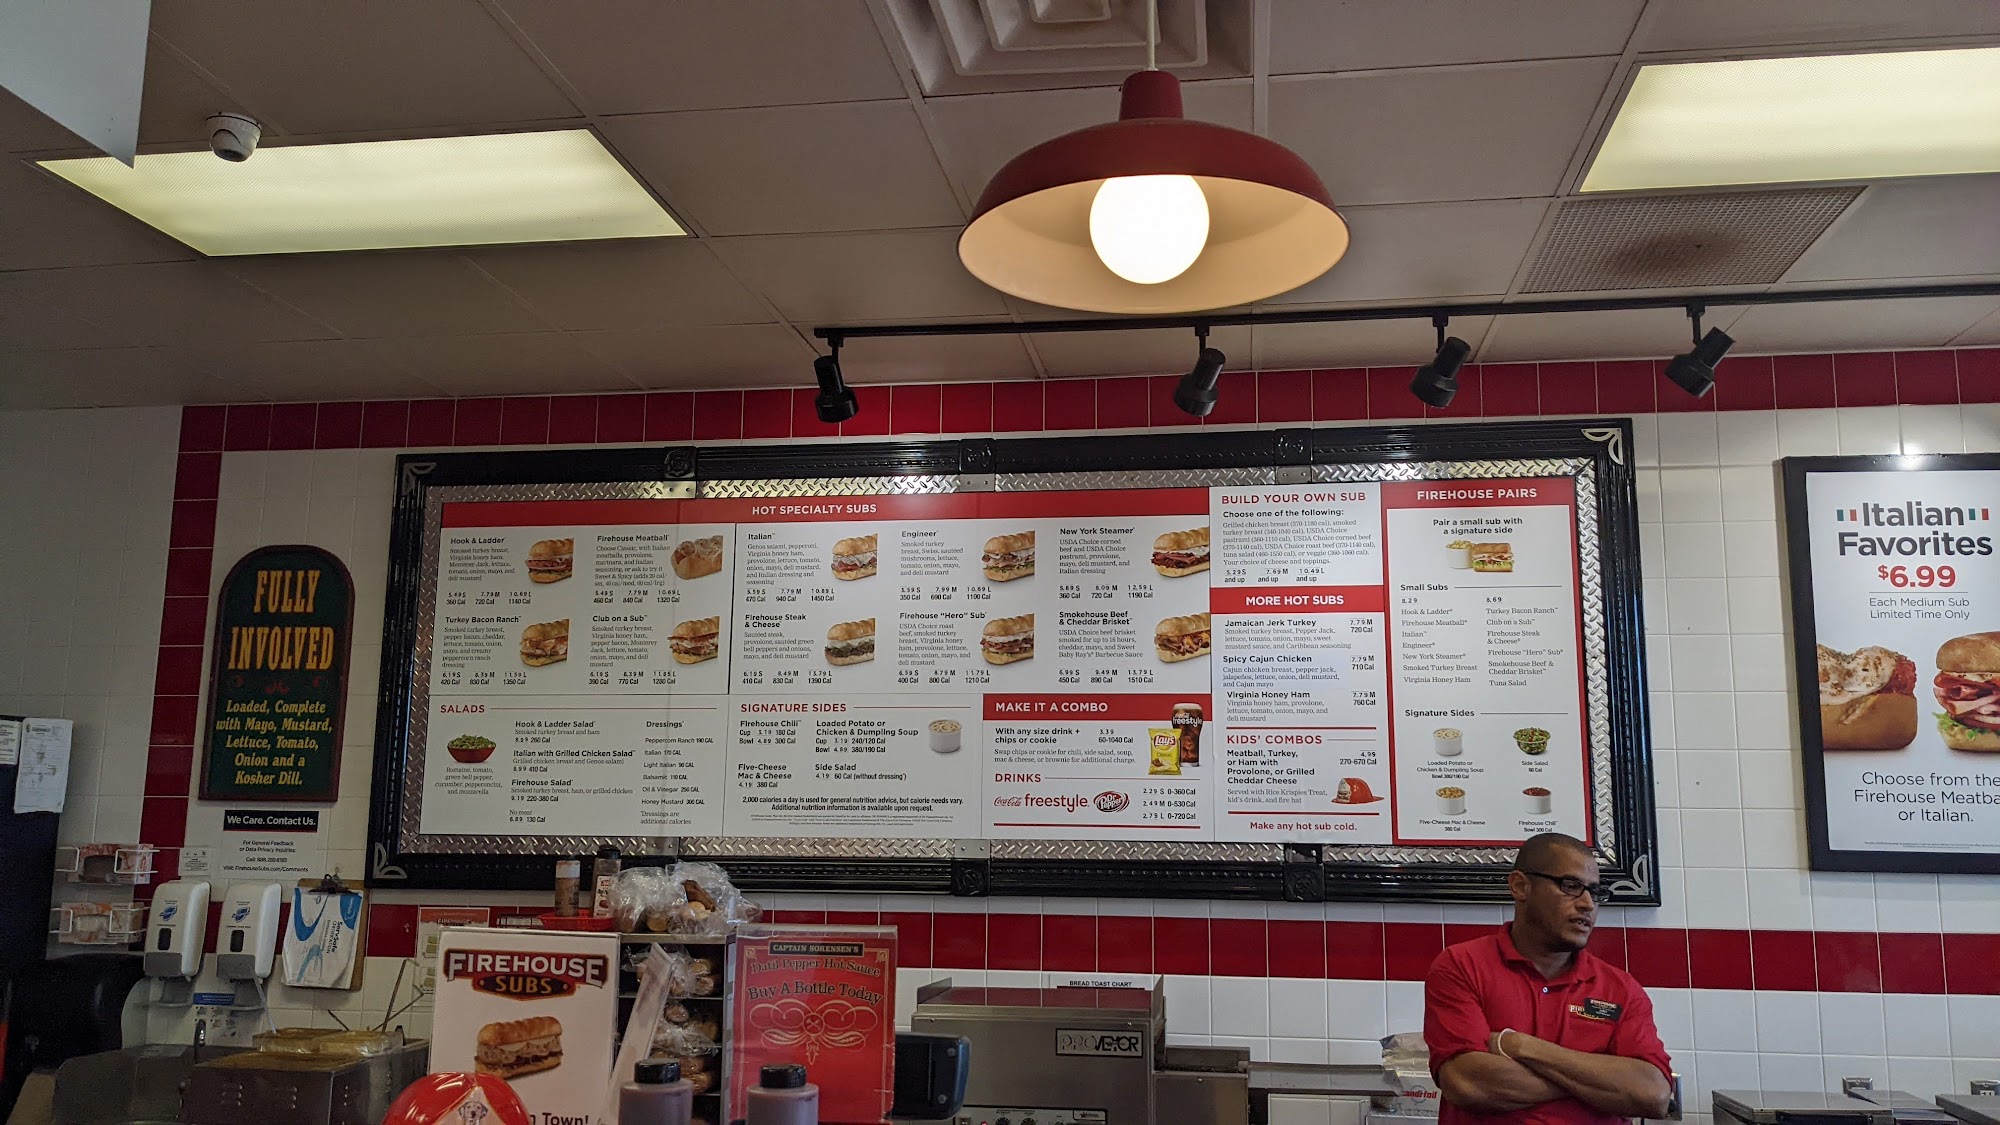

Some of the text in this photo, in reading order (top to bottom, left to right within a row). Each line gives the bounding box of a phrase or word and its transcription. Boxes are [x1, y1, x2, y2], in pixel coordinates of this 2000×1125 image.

[1221, 491, 1365, 504] BUILD YOUR OWN SUB
[1417, 487, 1537, 500] FIREHOUSE PAIRS
[752, 503, 876, 515] HOT SPECIALTY SUBS
[1222, 510, 1254, 518] Choose
[1274, 509, 1283, 517] of
[1301, 508, 1343, 517] following:
[1862, 501, 1964, 526] Italian
[1433, 518, 1450, 526] Pair
[1485, 517, 1501, 525] sub
[1450, 526, 1492, 535] signature
[1494, 526, 1512, 534] side
[1838, 530, 1992, 555] Favorites
[1877, 565, 1955, 587] $6.99
[254, 570, 319, 612] FULLY
[1245, 595, 1344, 605] MORE HOT SUBS
[1869, 597, 1969, 606] Each Medium Sub
[745, 614, 783, 622] Firehouse
[1870, 609, 1970, 620] Limited Time Only
[1224, 619, 1264, 627] Jamaican
[1286, 618, 1316, 627] Turkey
[228, 627, 333, 669] INVOLVED
[1222, 655, 1246, 663] Spicy
[1249, 655, 1274, 663] Cajun
[1226, 691, 1259, 699] Virginia
[1261, 691, 1288, 699] Honey
[225, 698, 326, 717] Loaded, Complete
[440, 704, 484, 713] SALADS
[740, 703, 846, 712] SIGNATURE SIDES
[995, 702, 1108, 711] MAKE IT A COMBO
[1405, 709, 1448, 717] Signature
[215, 716, 332, 735] with Mayo, Mustard,
[857, 728, 895, 737] Dumpling
[898, 728, 918, 736] Soup
[995, 727, 1015, 735] With
[1016, 729, 1032, 737] any
[1033, 727, 1050, 736] size
[225, 734, 318, 750] Lettuce, Tomato,
[994, 736, 1016, 744] chips
[1227, 734, 1322, 744] KIDS' COMBOS
[234, 752, 305, 766] Onion and a
[1227, 749, 1298, 758] Meatball, Turkey,
[234, 770, 302, 785] Kosher Dill.
[995, 773, 1041, 782] DRINKS
[1862, 771, 2000, 786] Choose from the
[1854, 789, 1935, 803] Firehouse
[1024, 793, 1088, 812] freestyle
[1898, 808, 1973, 821] or Italian.
[226, 815, 316, 826] We Care. Contact Us.
[1250, 821, 1357, 831] Make any hot sub cold.
[447, 953, 603, 988] FIREHOUSE
[782, 959, 820, 970] Pepper
[824, 959, 844, 968] Hot
[846, 960, 880, 976] Sauce
[496, 976, 552, 993] SUBS
[748, 980, 882, 1006] Buy A Bottle Today
